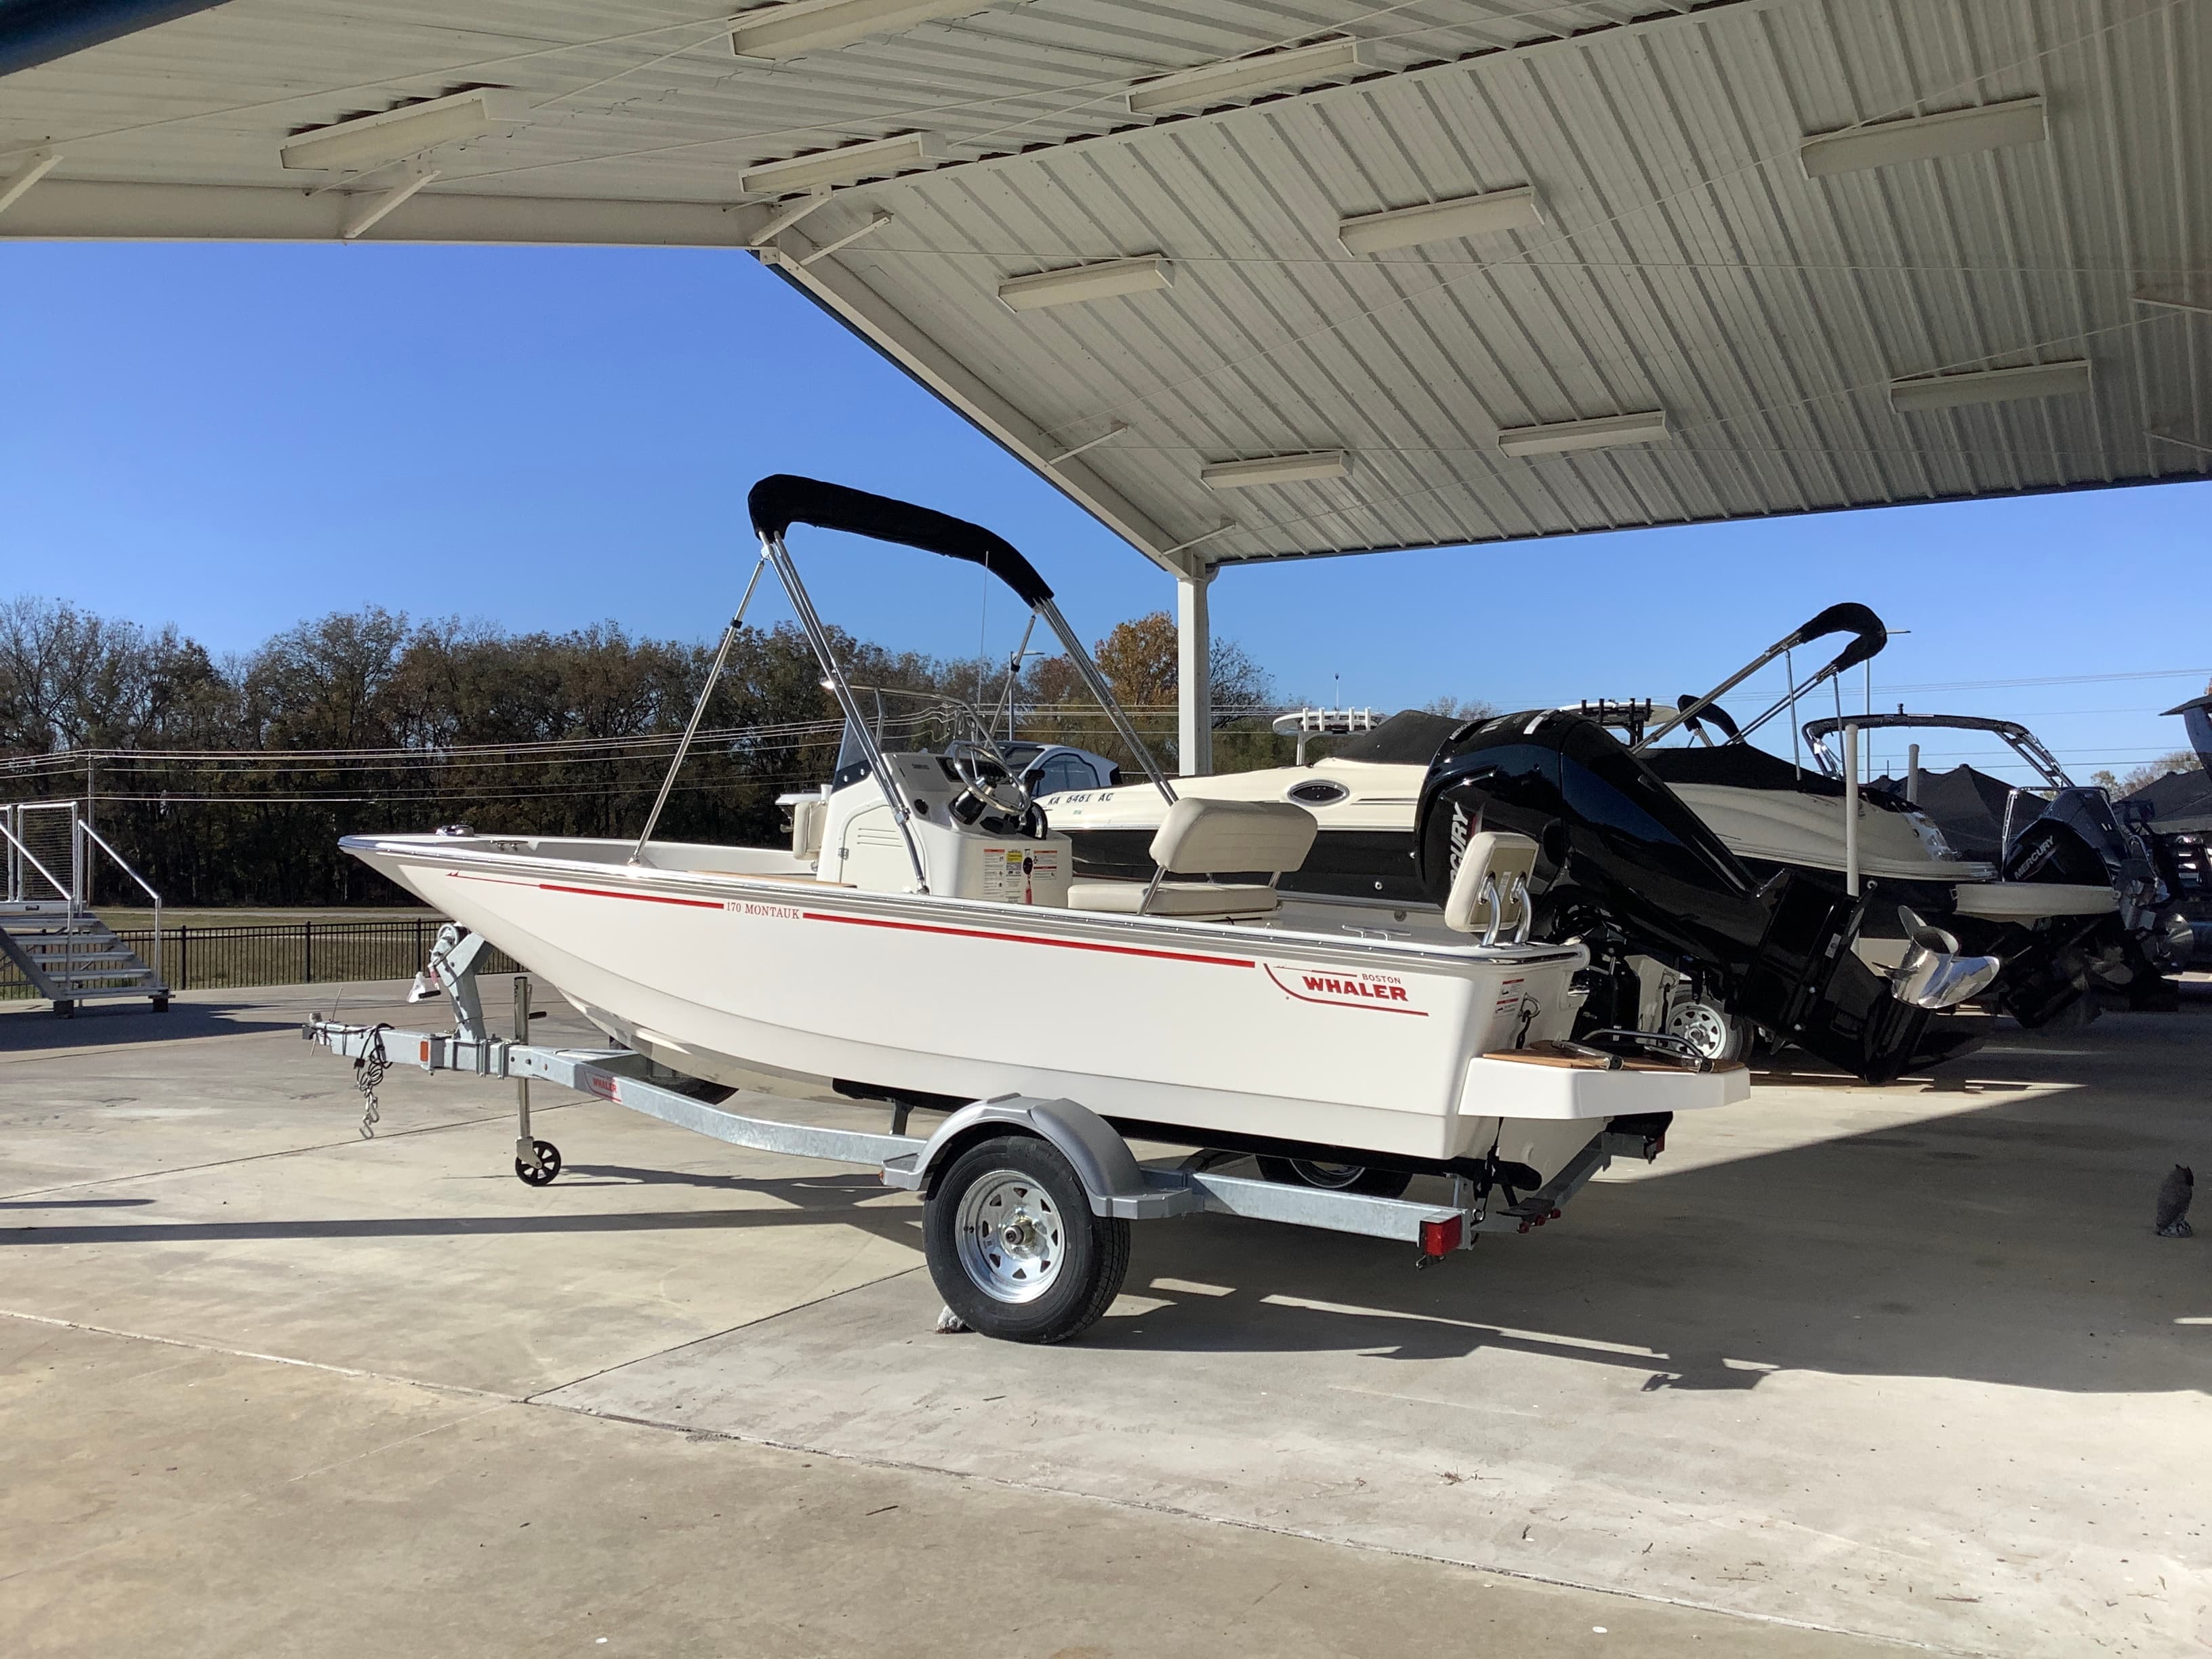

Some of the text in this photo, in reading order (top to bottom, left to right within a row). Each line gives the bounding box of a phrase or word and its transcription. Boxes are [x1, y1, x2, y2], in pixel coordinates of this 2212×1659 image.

[1048, 792, 1114, 805] KA 6461 AC
[2014, 835, 2054, 880] MERCURY
[726, 902, 800, 919] 170 MONTAUK
[1362, 973, 1401, 984] BOSTON
[1302, 976, 1409, 1002] WHALER
